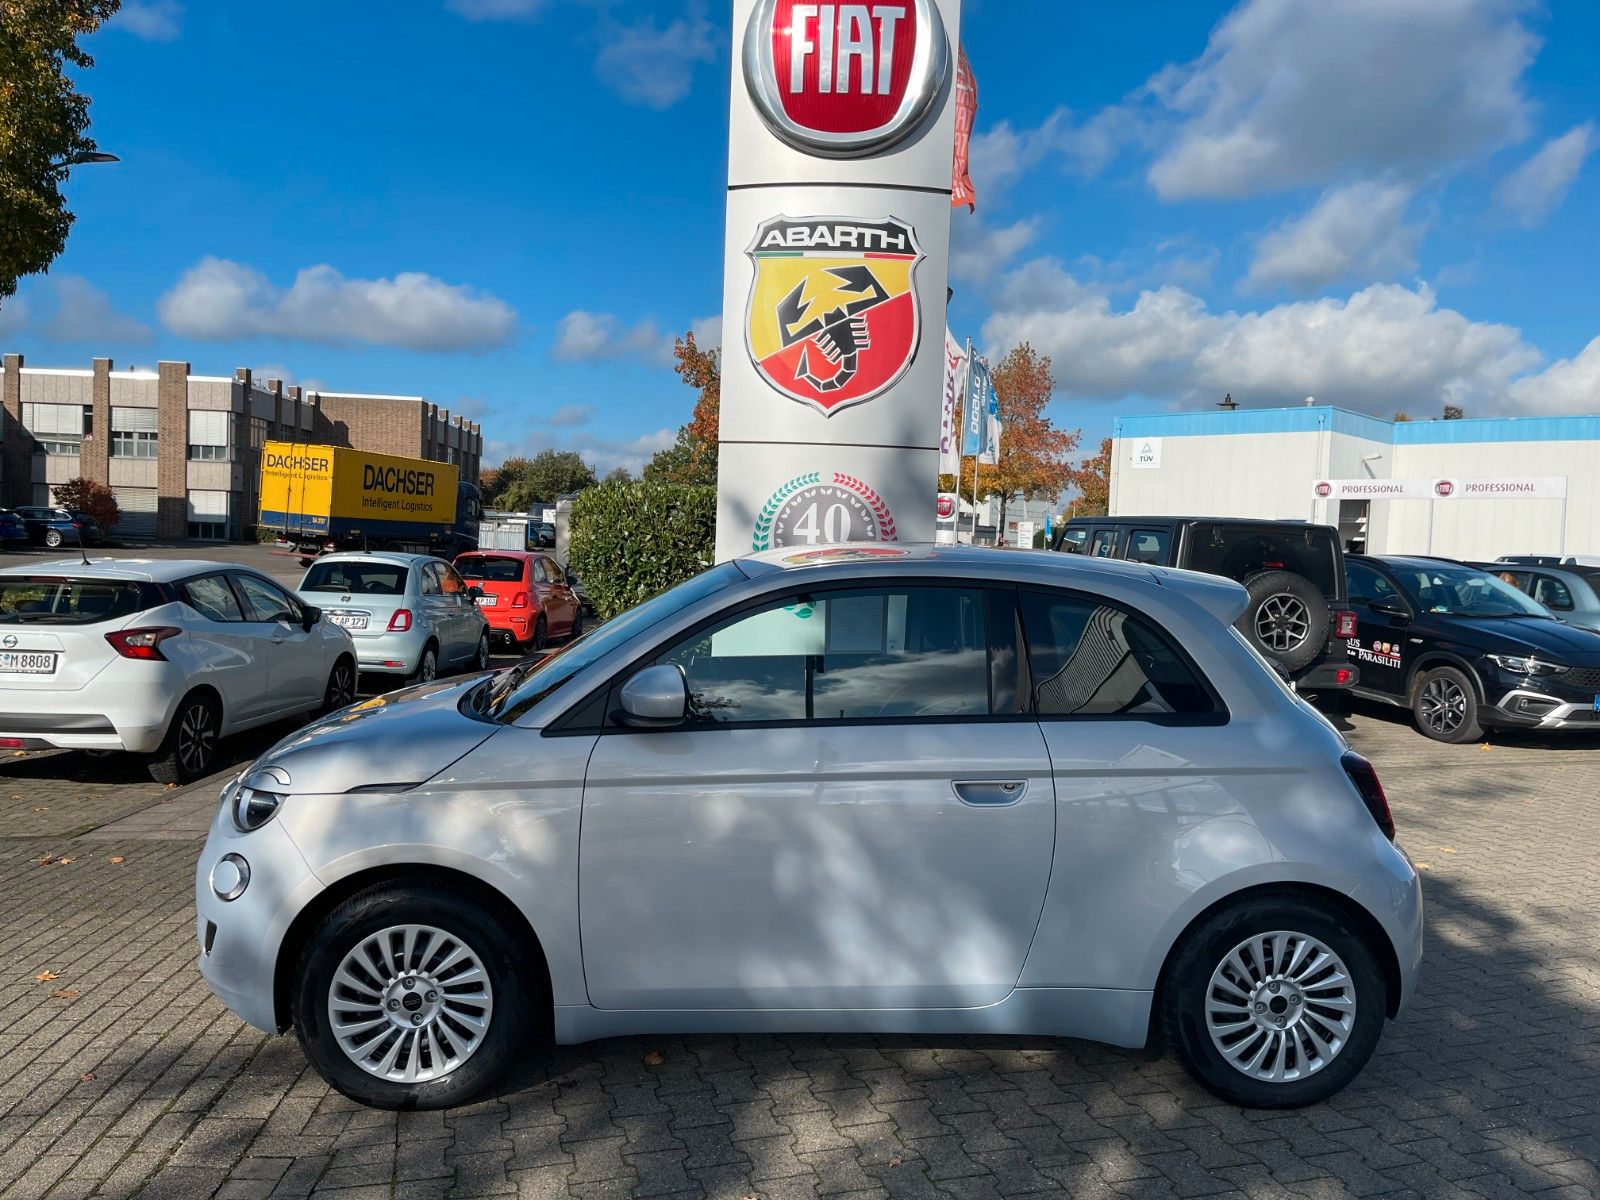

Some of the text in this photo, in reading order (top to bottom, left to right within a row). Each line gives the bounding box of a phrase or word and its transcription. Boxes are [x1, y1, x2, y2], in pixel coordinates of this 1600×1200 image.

[790, 4, 905, 96] FIAT
[761, 223, 905, 251] ABARTH
[266, 454, 329, 472] DACHSER
[1140, 454, 1153, 462] TÜV
[363, 463, 435, 497] DACHSER
[1342, 484, 1404, 494] PROFESSIONAL
[1465, 483, 1535, 493] PROFESSIONAL
[361, 496, 433, 513] Intelligent Logistics
[792, 502, 852, 544] 40
[21, 655, 51, 669] 8808
[1358, 650, 1401, 669] PARASILITI
